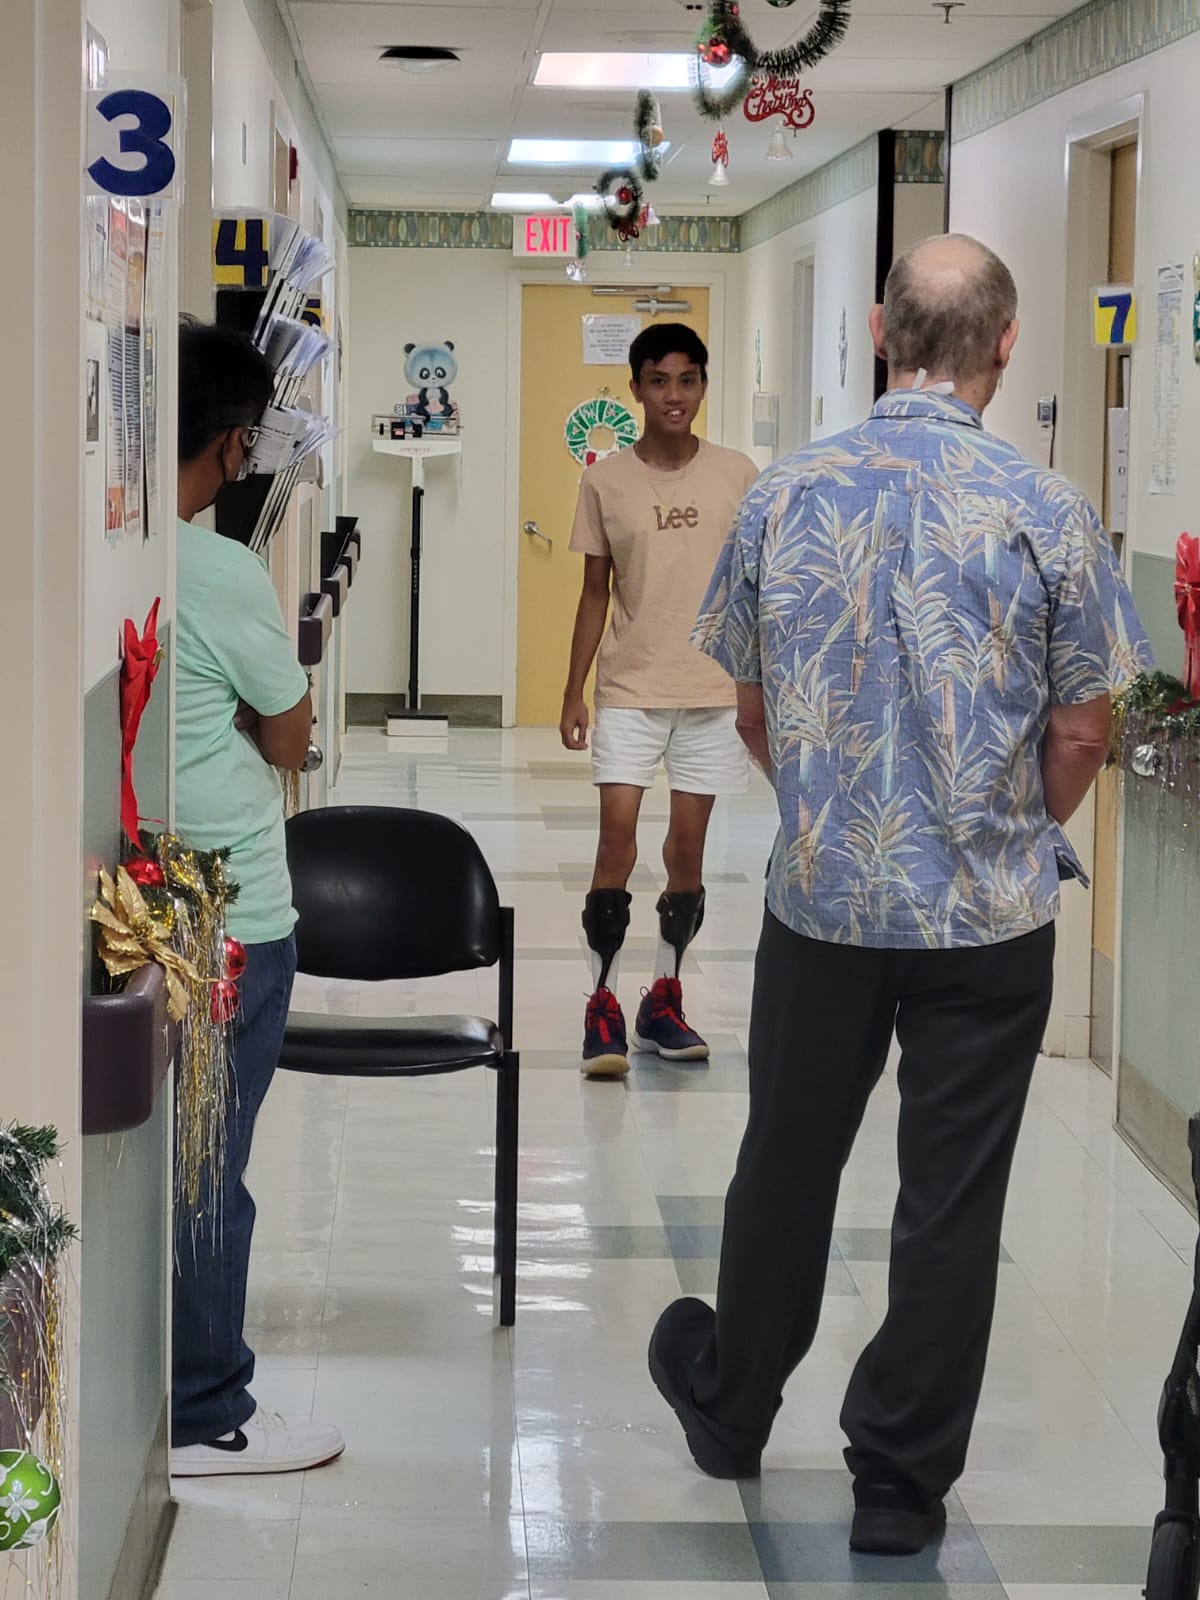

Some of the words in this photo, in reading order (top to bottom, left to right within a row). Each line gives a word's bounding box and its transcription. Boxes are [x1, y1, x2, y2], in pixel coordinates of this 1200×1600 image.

[743, 83, 815, 129] Christmas
[765, 75, 800, 98] Merry
[87, 88, 176, 196] 3
[215, 219, 269, 286] 4
[526, 217, 571, 252] EXIT
[1098, 292, 1132, 343] 7
[653, 505, 699, 531] Lee
